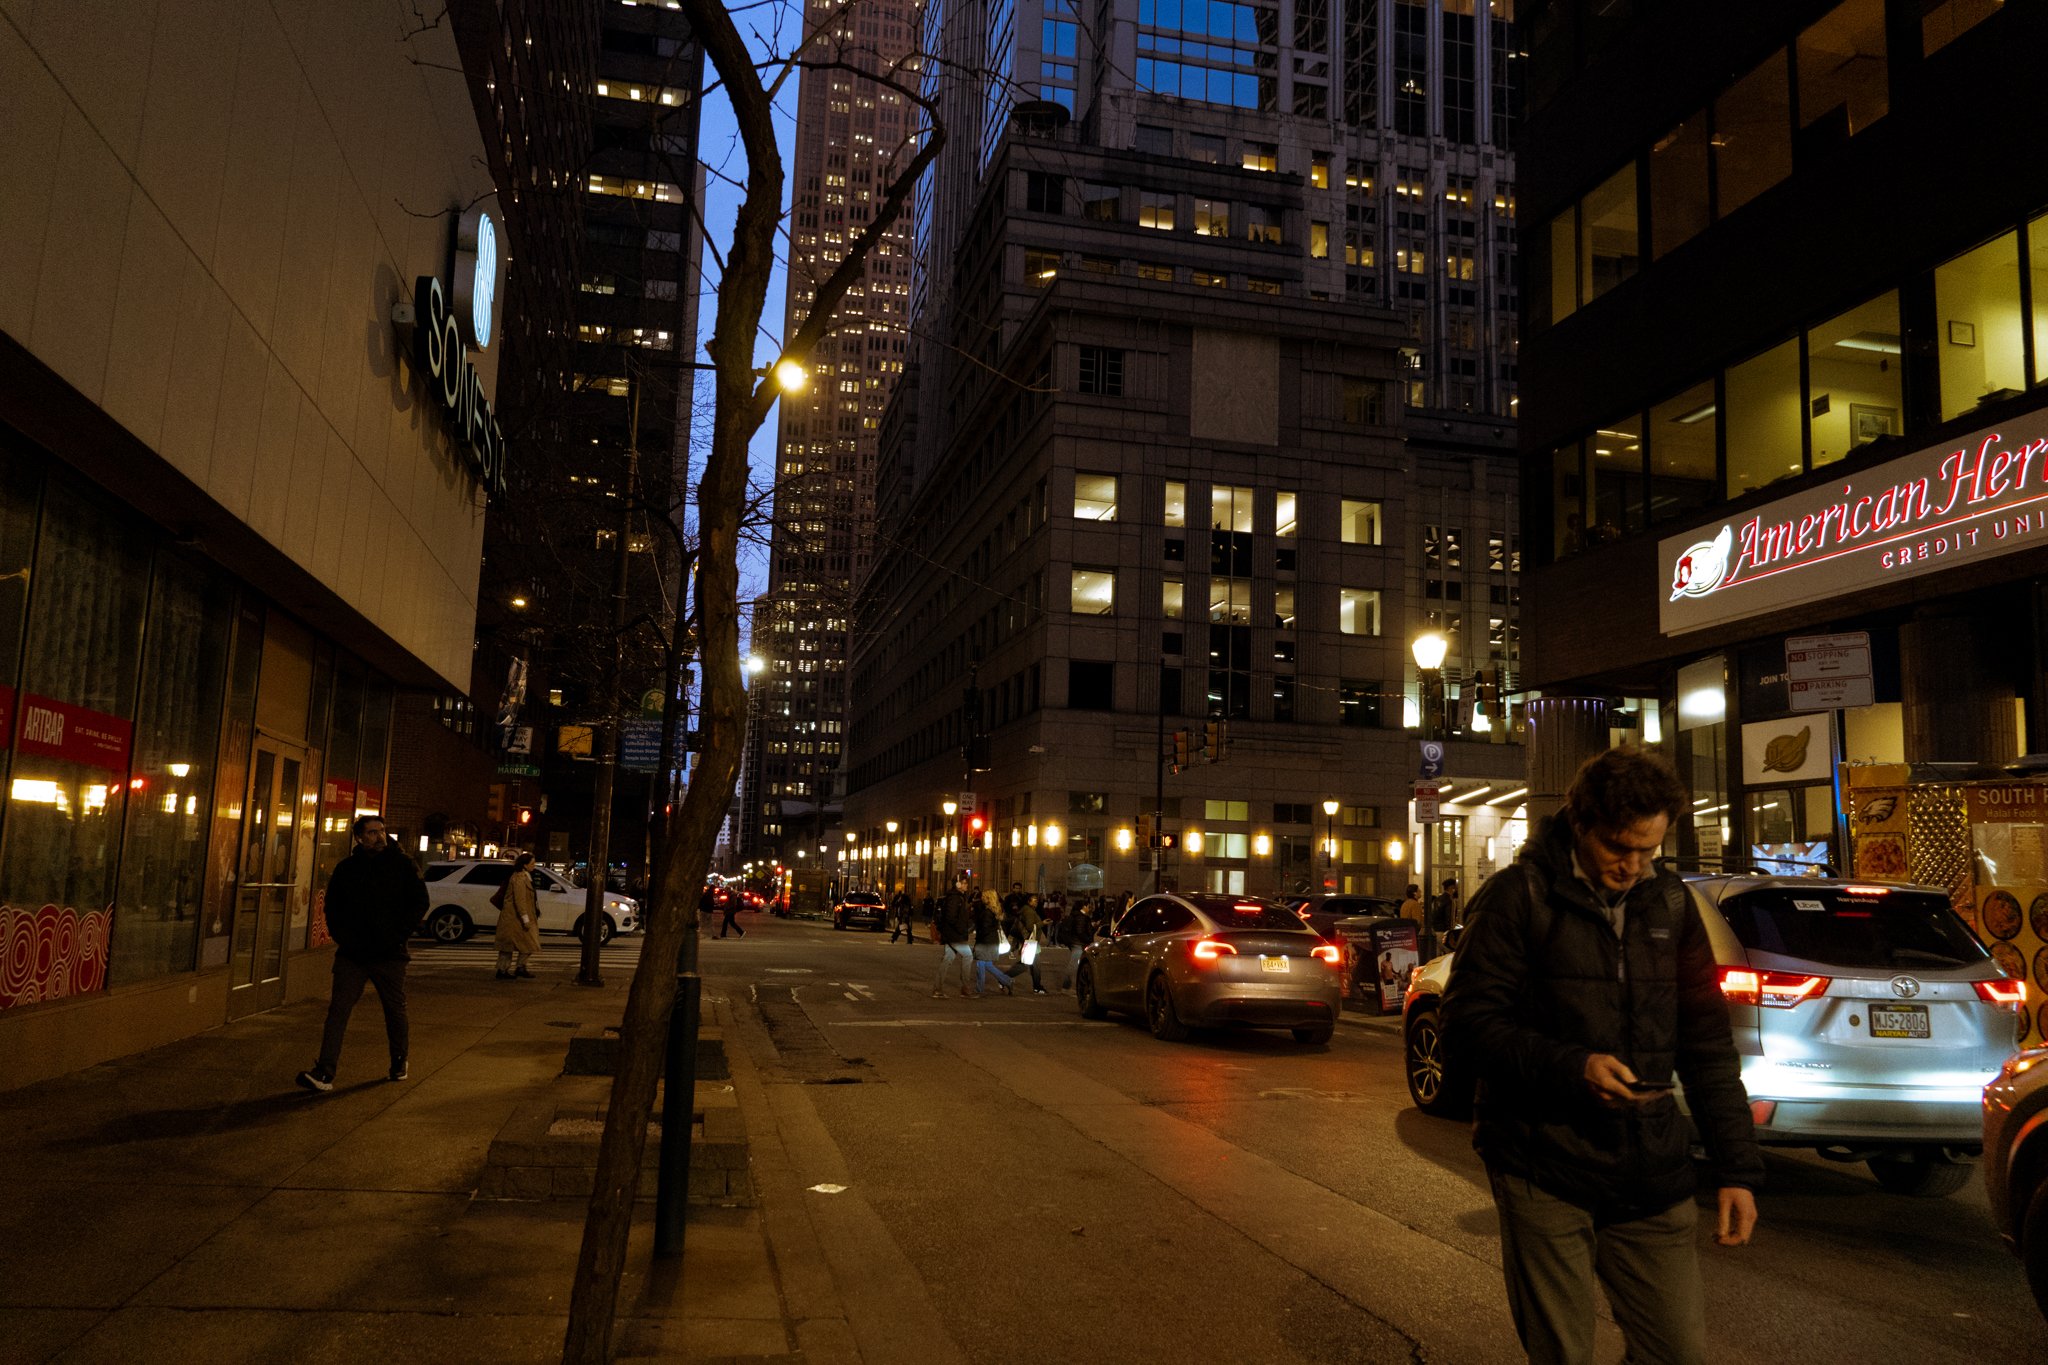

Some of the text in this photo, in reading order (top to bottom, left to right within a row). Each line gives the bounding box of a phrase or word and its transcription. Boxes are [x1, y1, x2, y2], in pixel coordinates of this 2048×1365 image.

[1725, 477, 1930, 582] American
[1881, 528, 1979, 569] CREDIT
[1791, 650, 1849, 661] NO STOPPING
[1760, 674, 1778, 685] JOIN
[1793, 681, 1847, 691] NO PARKING
[24, 706, 65, 746] ARTBAR
[497, 767, 527, 775] MARKET
[1979, 788, 2035, 804] SOUTH
[1987, 808, 2037, 818] Halal Food
